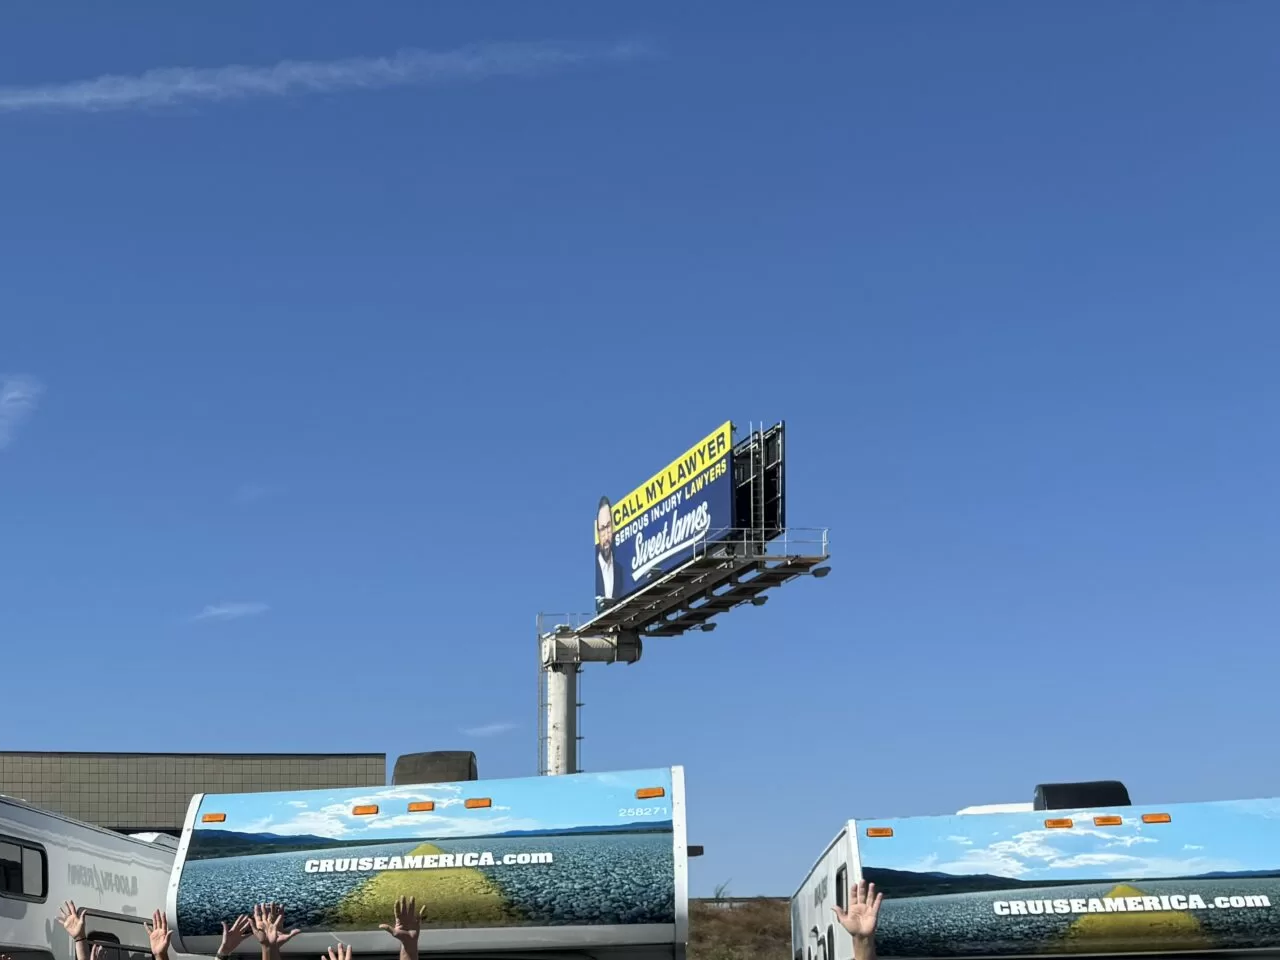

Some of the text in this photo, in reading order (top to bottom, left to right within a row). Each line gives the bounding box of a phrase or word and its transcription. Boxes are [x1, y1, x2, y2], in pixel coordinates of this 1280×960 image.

[613, 432, 726, 527] CALL MY LAWYER
[615, 458, 727, 547] SERIOUS INJURY LAWYERS
[618, 806, 668, 817] 258271
[304, 852, 553, 873] CRUISEAMERICA.com
[993, 894, 1271, 916] CRUISEAMERICA.com
